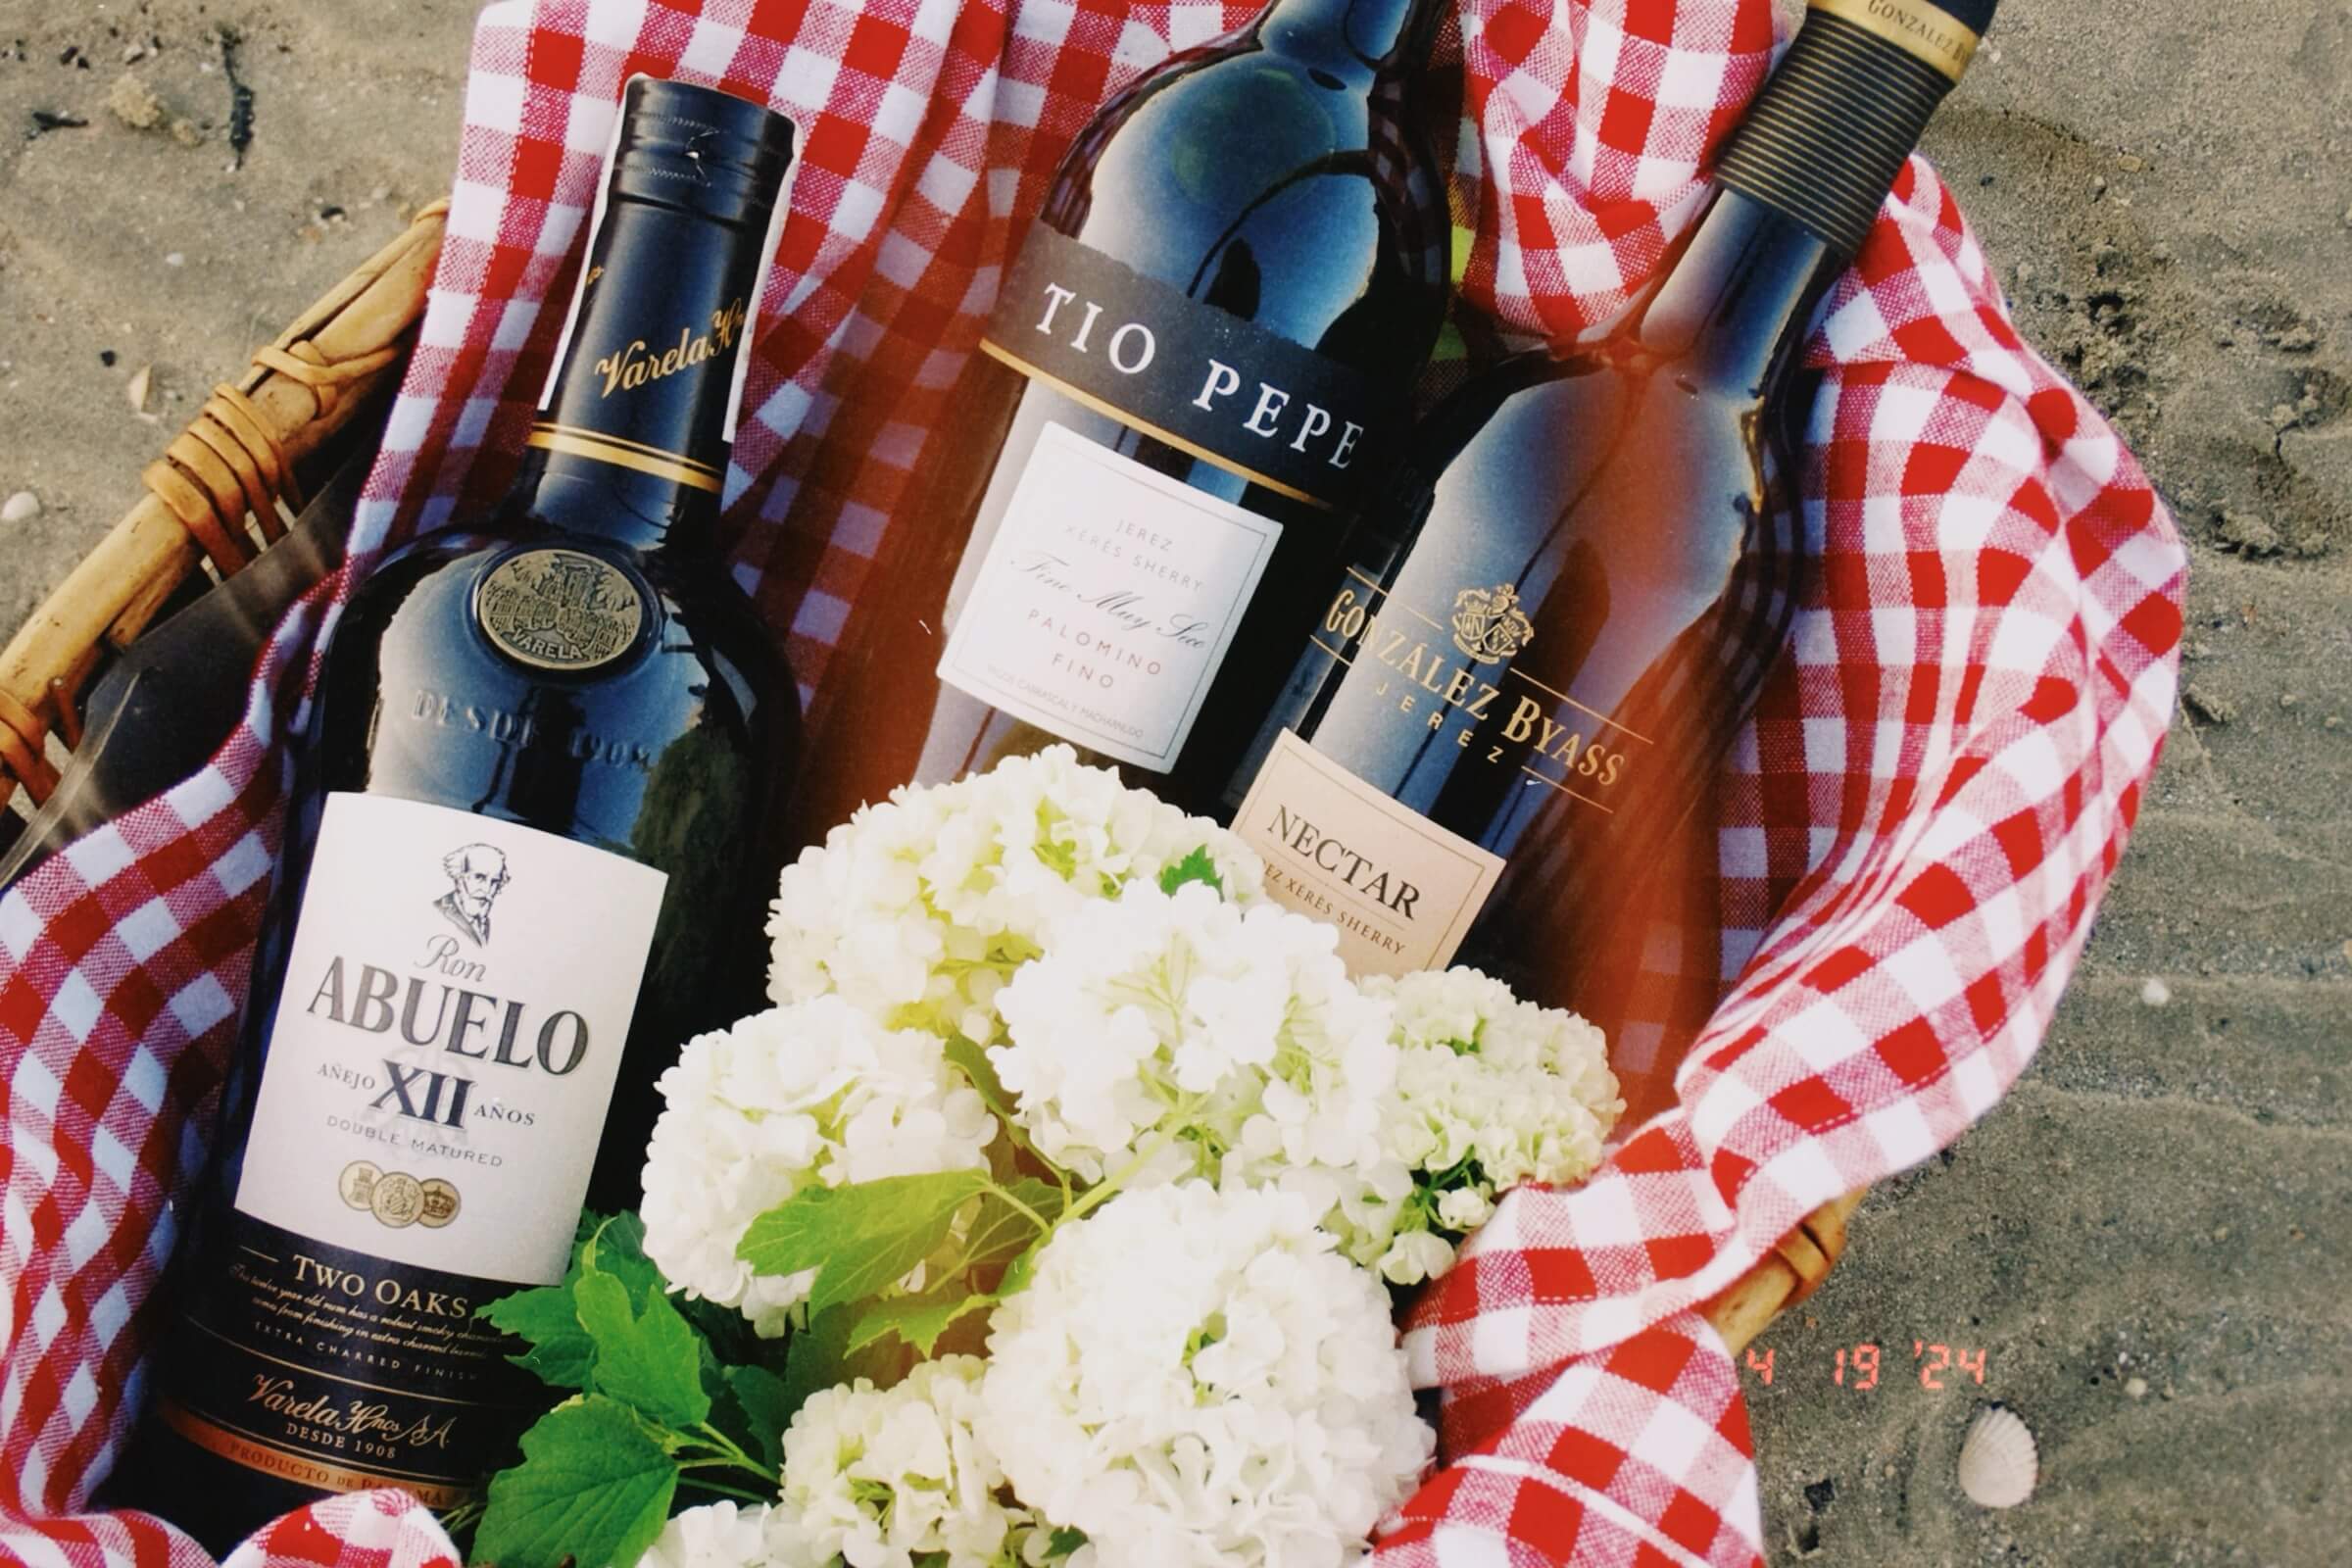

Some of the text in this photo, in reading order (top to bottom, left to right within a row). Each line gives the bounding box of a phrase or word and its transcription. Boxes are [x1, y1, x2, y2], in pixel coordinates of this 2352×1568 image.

[594, 326, 713, 399] Varela
[1036, 282, 1364, 469] TIO PEPE
[1115, 518, 1174, 552] JEREZ
[1133, 555, 1205, 591] SHERRY
[1076, 590, 1152, 631] Muy
[511, 628, 583, 661] VARELA
[1027, 608, 1162, 676] PALOMINO
[1051, 652, 1114, 689] FINO
[410, 689, 652, 768] DESDE 1908
[1375, 681, 1504, 764] JEREZ
[1499, 695, 1625, 786] BYASS
[1265, 804, 1422, 921] NECTAR
[1337, 910, 1406, 955] SHERRY
[414, 934, 488, 983] Ron
[306, 955, 590, 1077] ABUELO
[317, 1057, 536, 1131] AÑEJO XII AÑOS
[325, 1114, 503, 1167] DOUBLE MATURED
[293, 1253, 468, 1318] TWO OAKS
[304, 1294, 325, 1307] old
[347, 1304, 368, 1320] has
[368, 1314, 378, 1323] a
[255, 1320, 304, 1346] EXTRA
[316, 1341, 401, 1370] CHARRED
[275, 1301, 304, 1319] from
[302, 1310, 354, 1338] finishing
[354, 1328, 368, 1339] in
[248, 1373, 341, 1430] Varela
[229, 1441, 329, 1484] PRODUCTO
[285, 1422, 396, 1459] DESDE 1908
